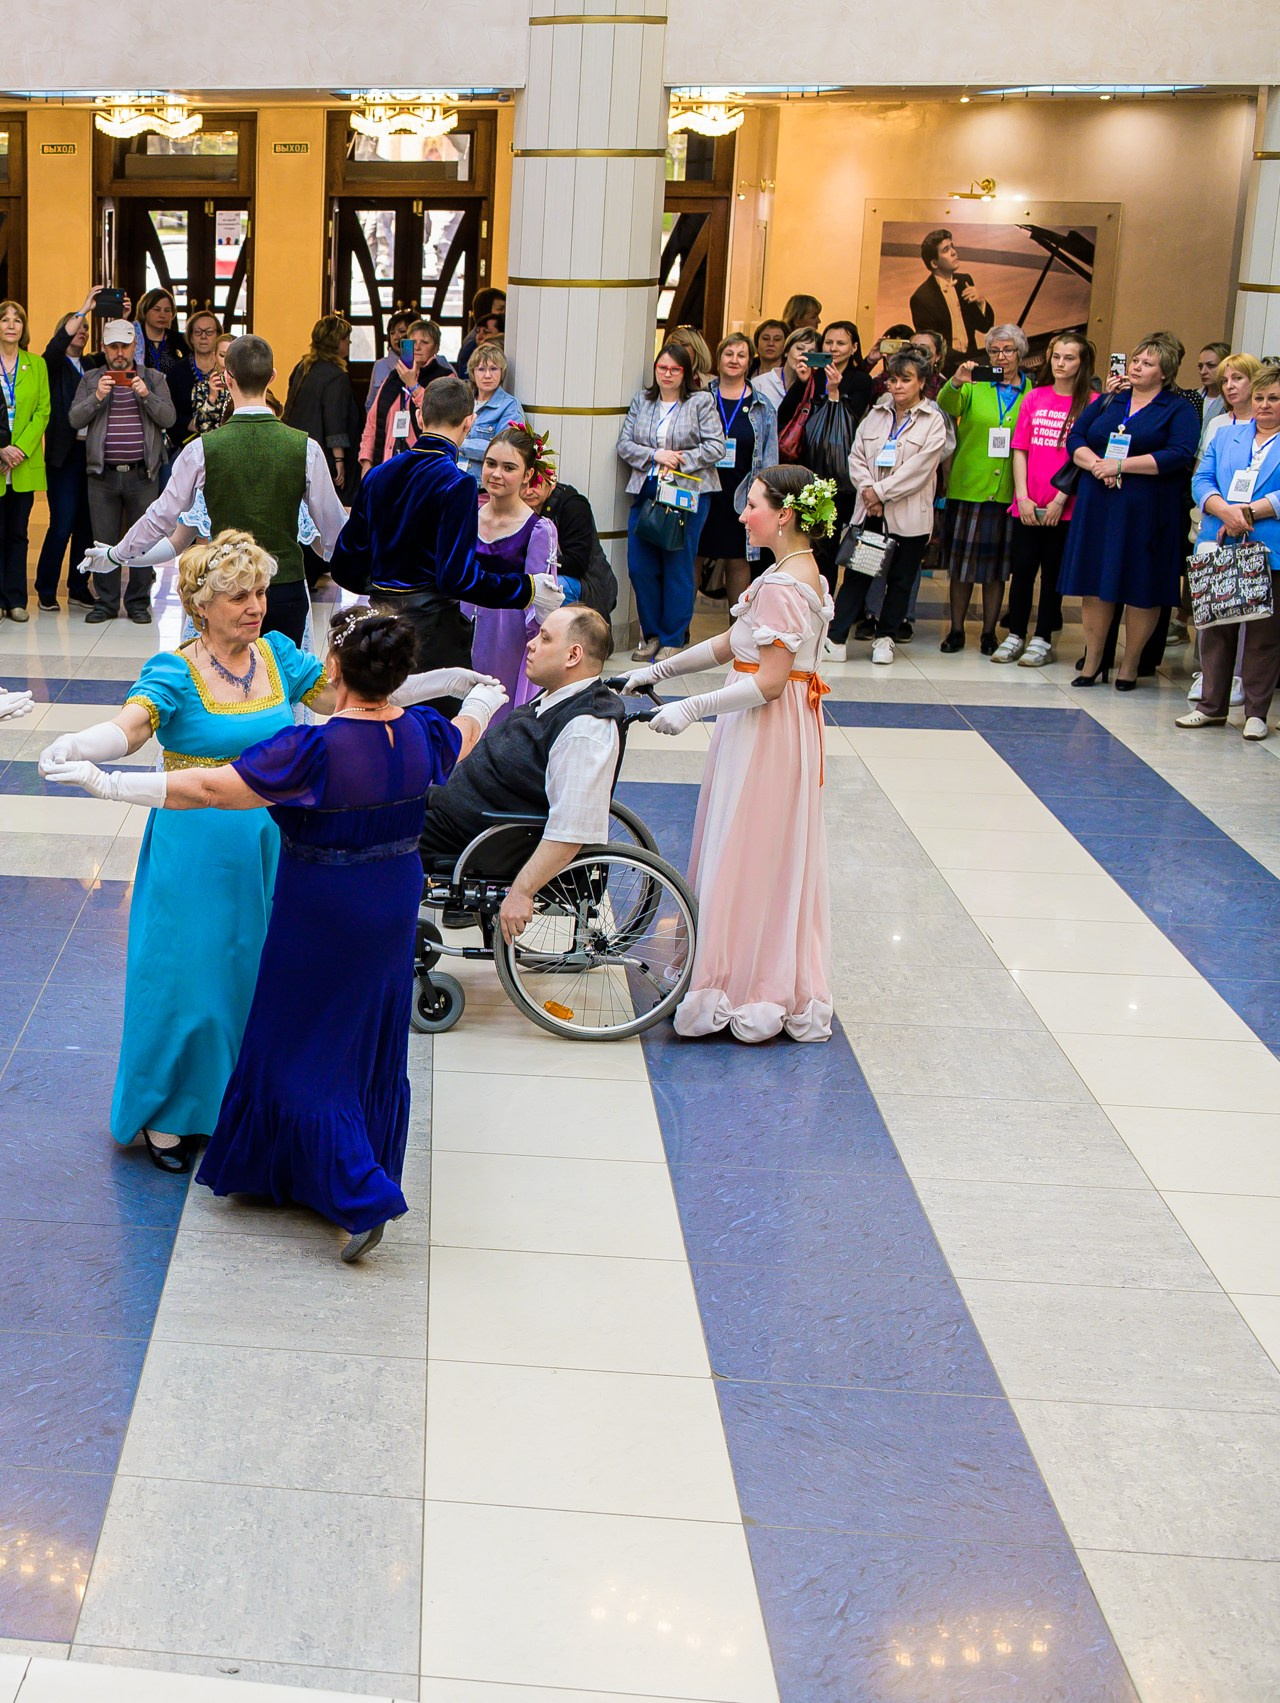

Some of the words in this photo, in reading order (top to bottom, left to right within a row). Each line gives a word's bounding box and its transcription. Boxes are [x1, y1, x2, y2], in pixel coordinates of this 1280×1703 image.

[43, 145, 74, 154] ВЫХОД
[275, 144, 307, 153] ВЫХОД
[1033, 427, 1039, 435] С
